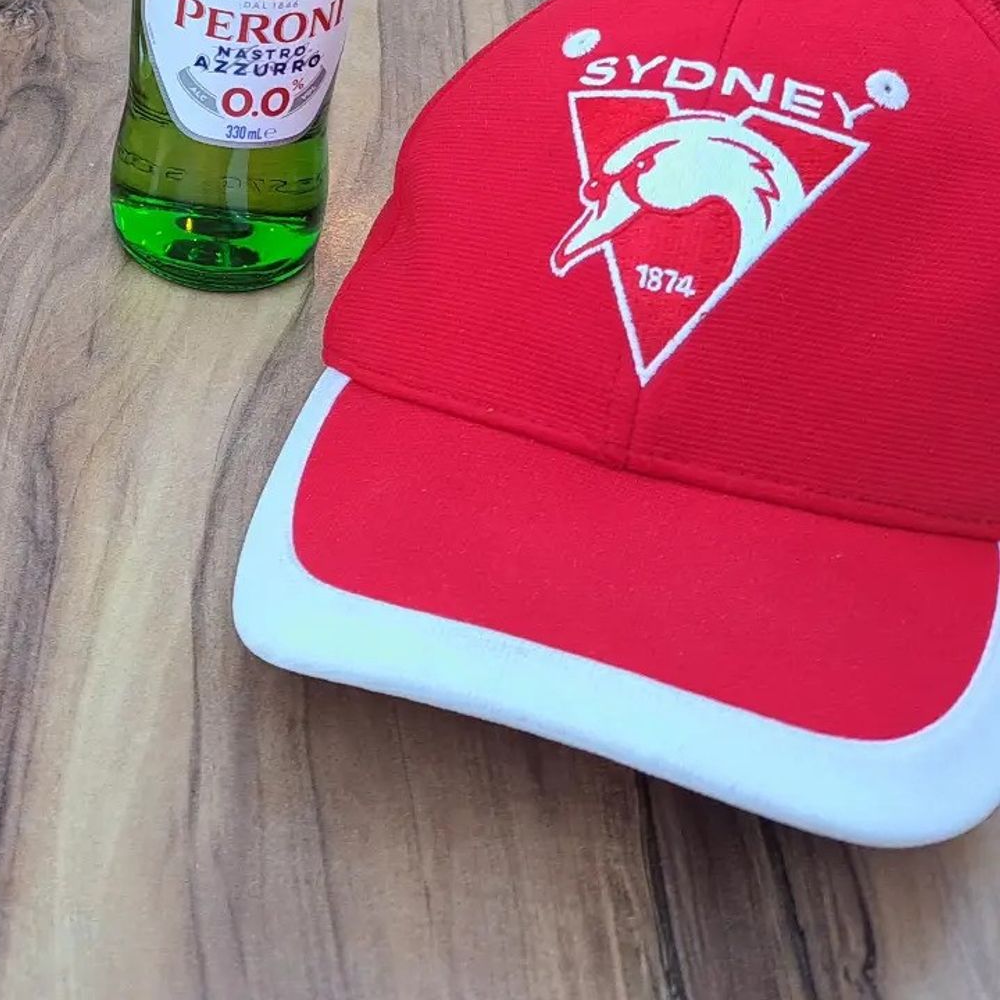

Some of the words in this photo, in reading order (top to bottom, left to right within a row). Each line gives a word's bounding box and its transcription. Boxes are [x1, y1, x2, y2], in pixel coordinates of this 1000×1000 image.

[193, 53, 321, 77] AZZURRO
[217, 45, 307, 61] NASTRO
[578, 54, 875, 129] SYDNEY
[635, 263, 696, 298] 1874
